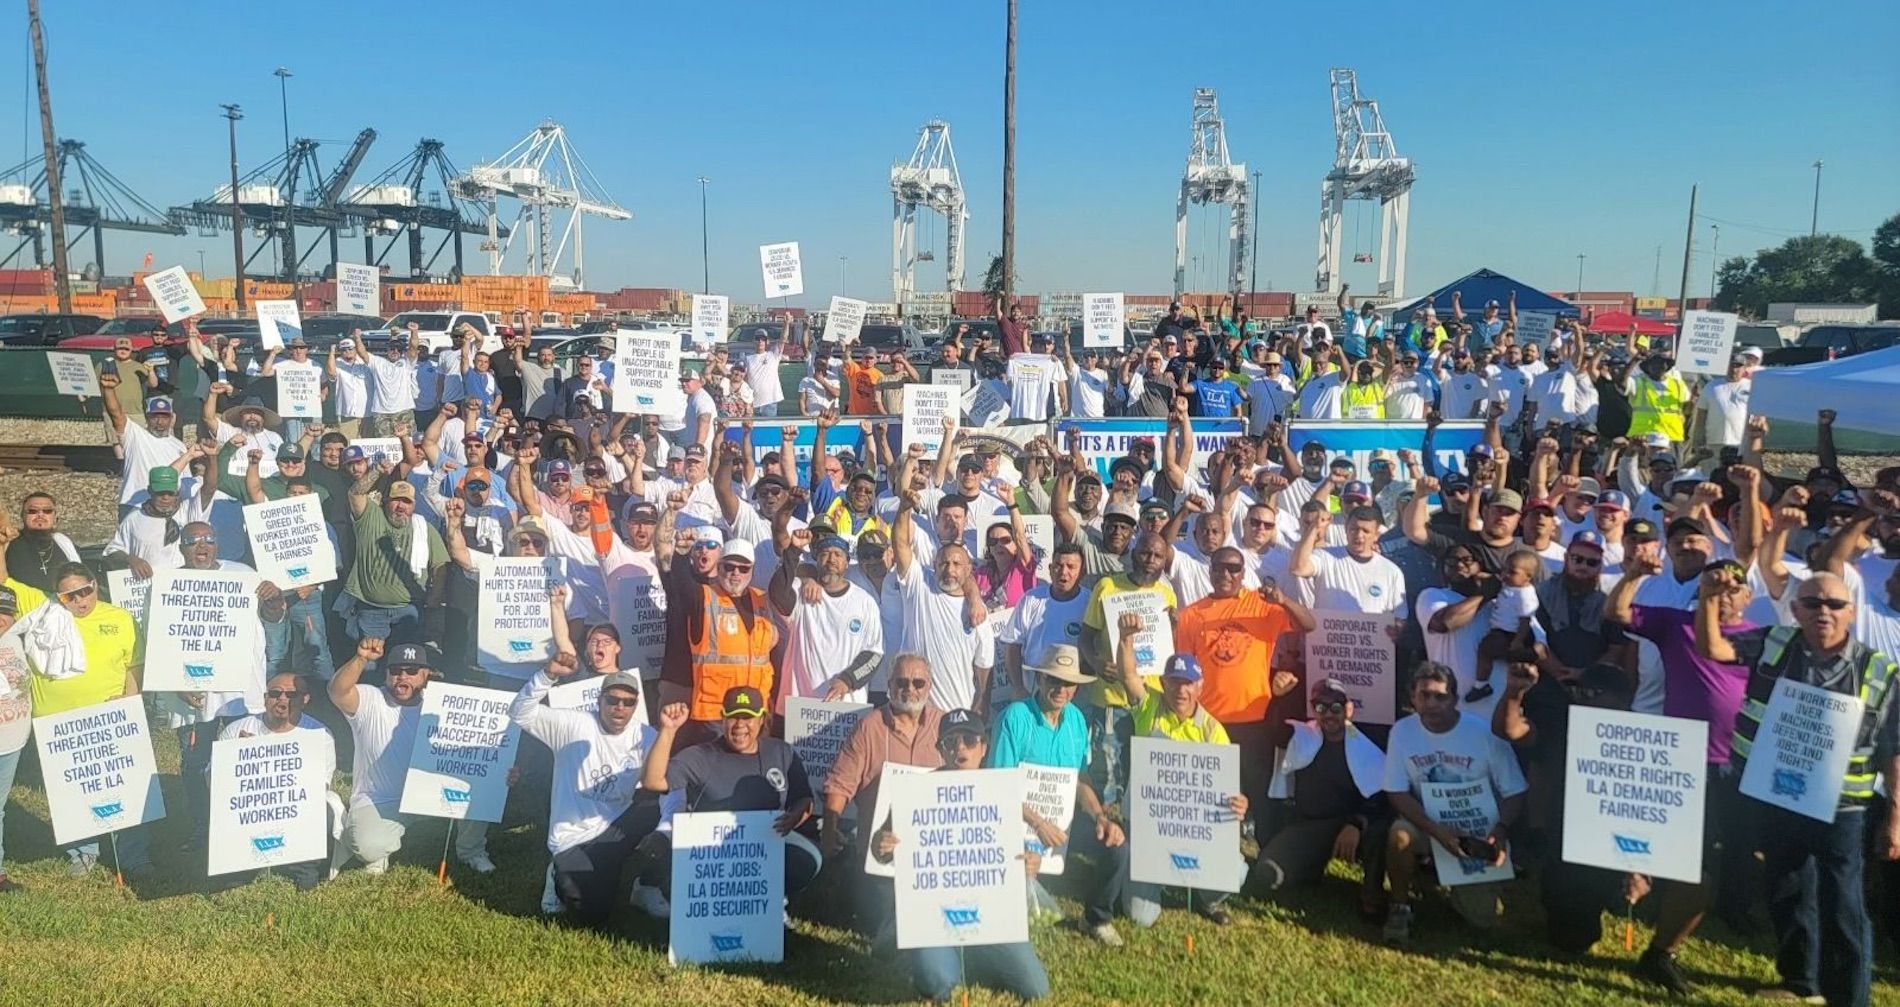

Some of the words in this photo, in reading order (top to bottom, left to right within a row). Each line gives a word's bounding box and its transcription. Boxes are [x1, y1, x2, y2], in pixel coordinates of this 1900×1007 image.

[1107, 436, 1115, 450] A
[1196, 436, 1234, 451] WAN
[260, 503, 306, 519] CORPORATE
[265, 517, 291, 529] GREED
[293, 514, 305, 524] VS.
[254, 528, 289, 542] WORKER
[290, 522, 321, 535] RIGHTS:
[264, 542, 277, 552] ILA
[278, 534, 318, 549] DEMANDS
[274, 546, 312, 561] FAIRNESS
[494, 565, 551, 577] AUTOMATION
[171, 579, 242, 593] AUTOMATION
[485, 579, 514, 590] HURTS
[161, 593, 223, 607] THREATENS
[227, 596, 249, 608] OUR
[497, 592, 511, 603] ILA
[513, 592, 549, 603] STANDS
[181, 609, 226, 622] FUTURE:
[503, 605, 520, 616] FOR
[523, 605, 540, 615] JOB
[168, 624, 204, 636] STAND
[208, 625, 236, 637] WITH
[494, 618, 548, 629] PROTECTION
[1323, 619, 1378, 633] CORPORATE
[181, 639, 201, 650] THE
[204, 639, 221, 651] ILA
[638, 634, 666, 646] WORKE
[1327, 633, 1356, 646] GREED
[1359, 635, 1374, 646] VS.
[1312, 645, 1350, 658] WORKER
[1353, 647, 1389, 661] RIGHTS:
[1320, 659, 1334, 670] ILA
[1336, 660, 1383, 674] DEMANDS
[441, 694, 479, 712] PROFIT
[54, 709, 126, 737] AUTOMATION
[445, 710, 486, 728] PEOPLE
[487, 716, 498, 730] IS
[801, 708, 832, 720] PROFIT
[834, 711, 858, 724] OVER
[46, 728, 112, 754] THREATENS
[115, 722, 138, 738] OUR
[807, 723, 840, 737] PEOPLE
[1596, 723, 1678, 747] CORPORATE
[238, 741, 299, 761] MACHINES
[430, 741, 480, 760] SUPPORT
[481, 747, 499, 762] ILA
[793, 736, 845, 750] UNACCEPTA
[72, 742, 119, 764] FUTURE:
[1150, 751, 1187, 767] PROFIT
[1191, 754, 1219, 770] OVER
[1600, 742, 1644, 761] GREED
[1650, 749, 1670, 765] VS.
[63, 762, 101, 782] STAND
[103, 754, 134, 772] WITH
[235, 760, 269, 777] DON'T
[274, 757, 302, 771] FEED
[435, 757, 488, 777] WORKERS
[1577, 758, 1634, 779] WORKER
[1640, 767, 1694, 788] RIGHTS:
[79, 778, 102, 794] THE
[104, 772, 124, 788] ILA
[240, 773, 296, 792] FAMILIES:
[1157, 769, 1197, 786] PEOPLE
[1202, 773, 1212, 787] IS
[230, 790, 284, 810] SUPPORT
[288, 788, 306, 801] ILA
[937, 785, 974, 802] FIGHT
[1586, 779, 1607, 795] ILA
[1613, 782, 1682, 806] DEMANDS
[239, 804, 297, 824] WORKERS
[912, 805, 1001, 825] AUTOMATION,
[1149, 803, 1198, 821] SUPPORT
[1599, 799, 1666, 823] FAIRNESS
[713, 824, 744, 840] FIGHT
[919, 828, 952, 846] SAVE
[958, 826, 995, 844] JOBS:
[1157, 822, 1211, 840] WORKERS
[689, 842, 767, 860] AUTOMATION,
[913, 849, 935, 868] ILA
[937, 846, 1004, 867] DEMANDS
[695, 862, 725, 877] SAVE
[728, 861, 761, 877] JOBS:
[688, 880, 706, 896] ILA
[710, 879, 767, 896] DEMANDS
[912, 872, 937, 889] JOB
[942, 868, 1006, 887] SECURITY
[686, 899, 709, 915] JOB
[712, 898, 768, 915] SECURITY
